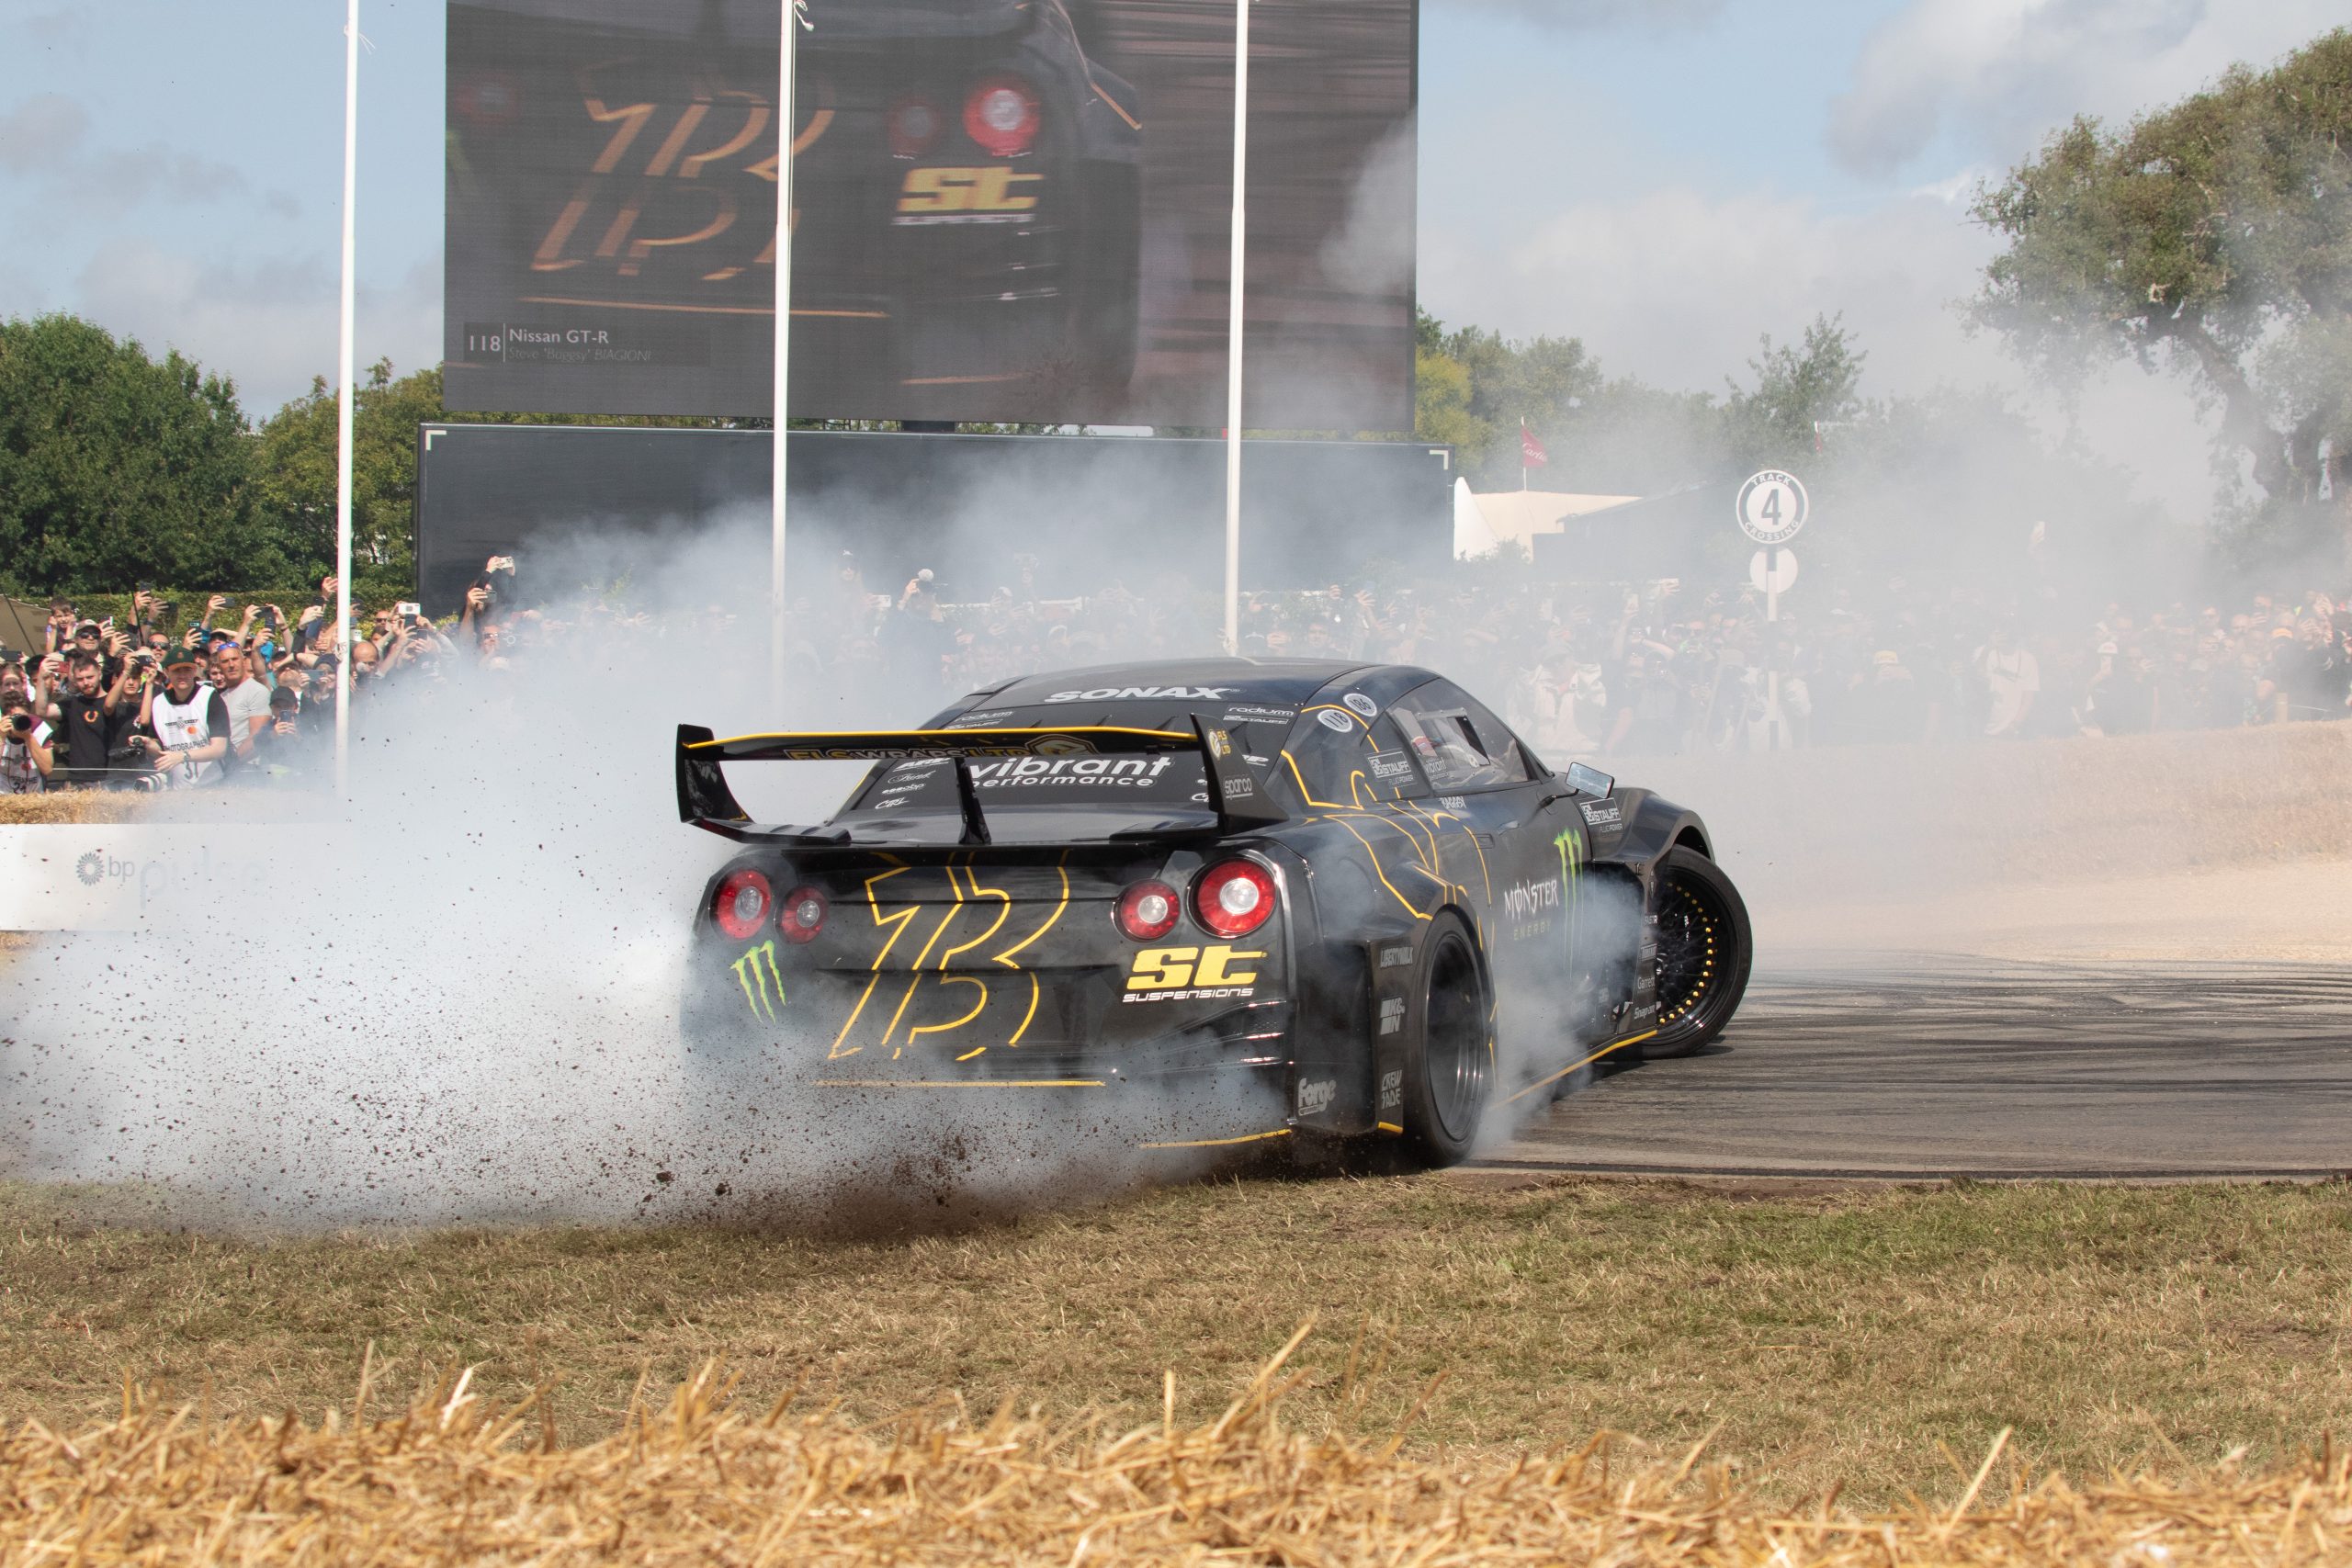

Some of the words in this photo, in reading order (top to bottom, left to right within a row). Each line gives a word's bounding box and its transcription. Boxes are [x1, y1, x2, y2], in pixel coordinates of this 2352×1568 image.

[469, 335, 502, 352] 118
[509, 328, 560, 344] Nissan
[566, 329, 609, 344] GT-R
[1751, 473, 1791, 486] TRACK
[1761, 488, 1781, 525] 4
[1745, 520, 1799, 540] CROSSING
[1045, 687, 1231, 702] SONAX
[1228, 706, 1295, 716] radium
[1324, 712, 1349, 728] 118
[969, 756, 1171, 778] vibrant
[1381, 761, 1410, 775] STAUFF
[1224, 777, 1254, 800] sparco
[1594, 808, 1621, 822] STAUFF
[108, 855, 135, 883] bp
[1504, 878, 1559, 919] MONSTER
[1513, 919, 1552, 941] ENERGY
[1126, 945, 1262, 989] st
[1122, 987, 1254, 1003] SUSPENSIONS
[1381, 1068, 1403, 1091] CREW
[1298, 1077, 1337, 1111] Forge
